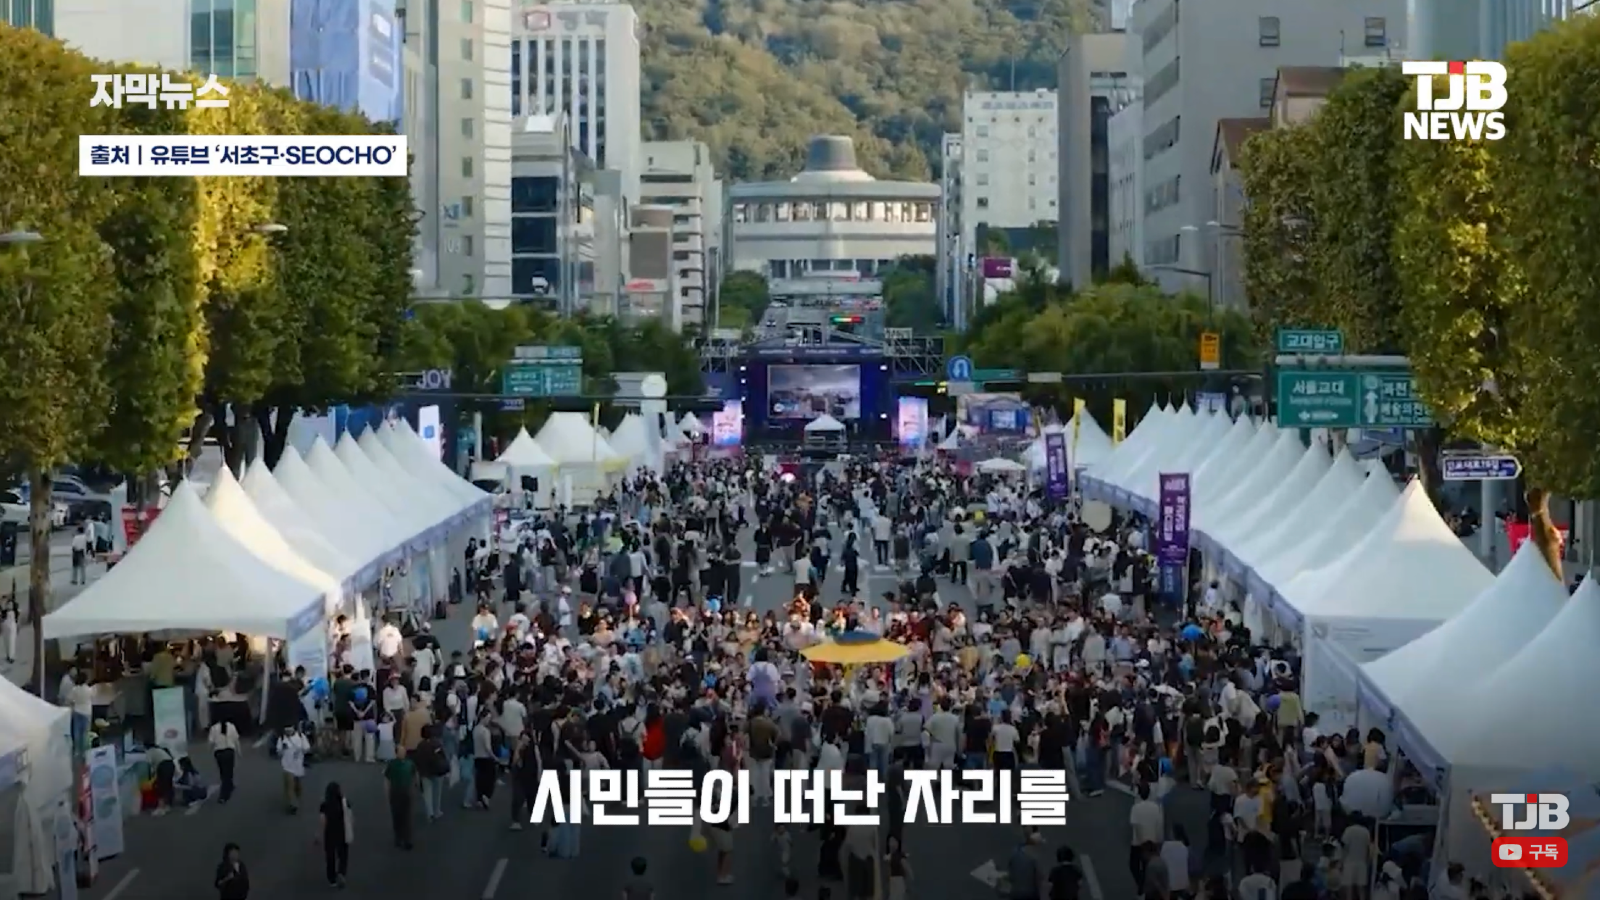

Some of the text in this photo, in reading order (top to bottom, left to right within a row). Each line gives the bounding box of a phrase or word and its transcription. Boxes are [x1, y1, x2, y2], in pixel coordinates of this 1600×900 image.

[1287, 335, 1339, 349] 교대입구
[416, 369, 452, 389] JOY
[1292, 380, 1345, 394] 서울교대
[1381, 382, 1407, 396] 과천
